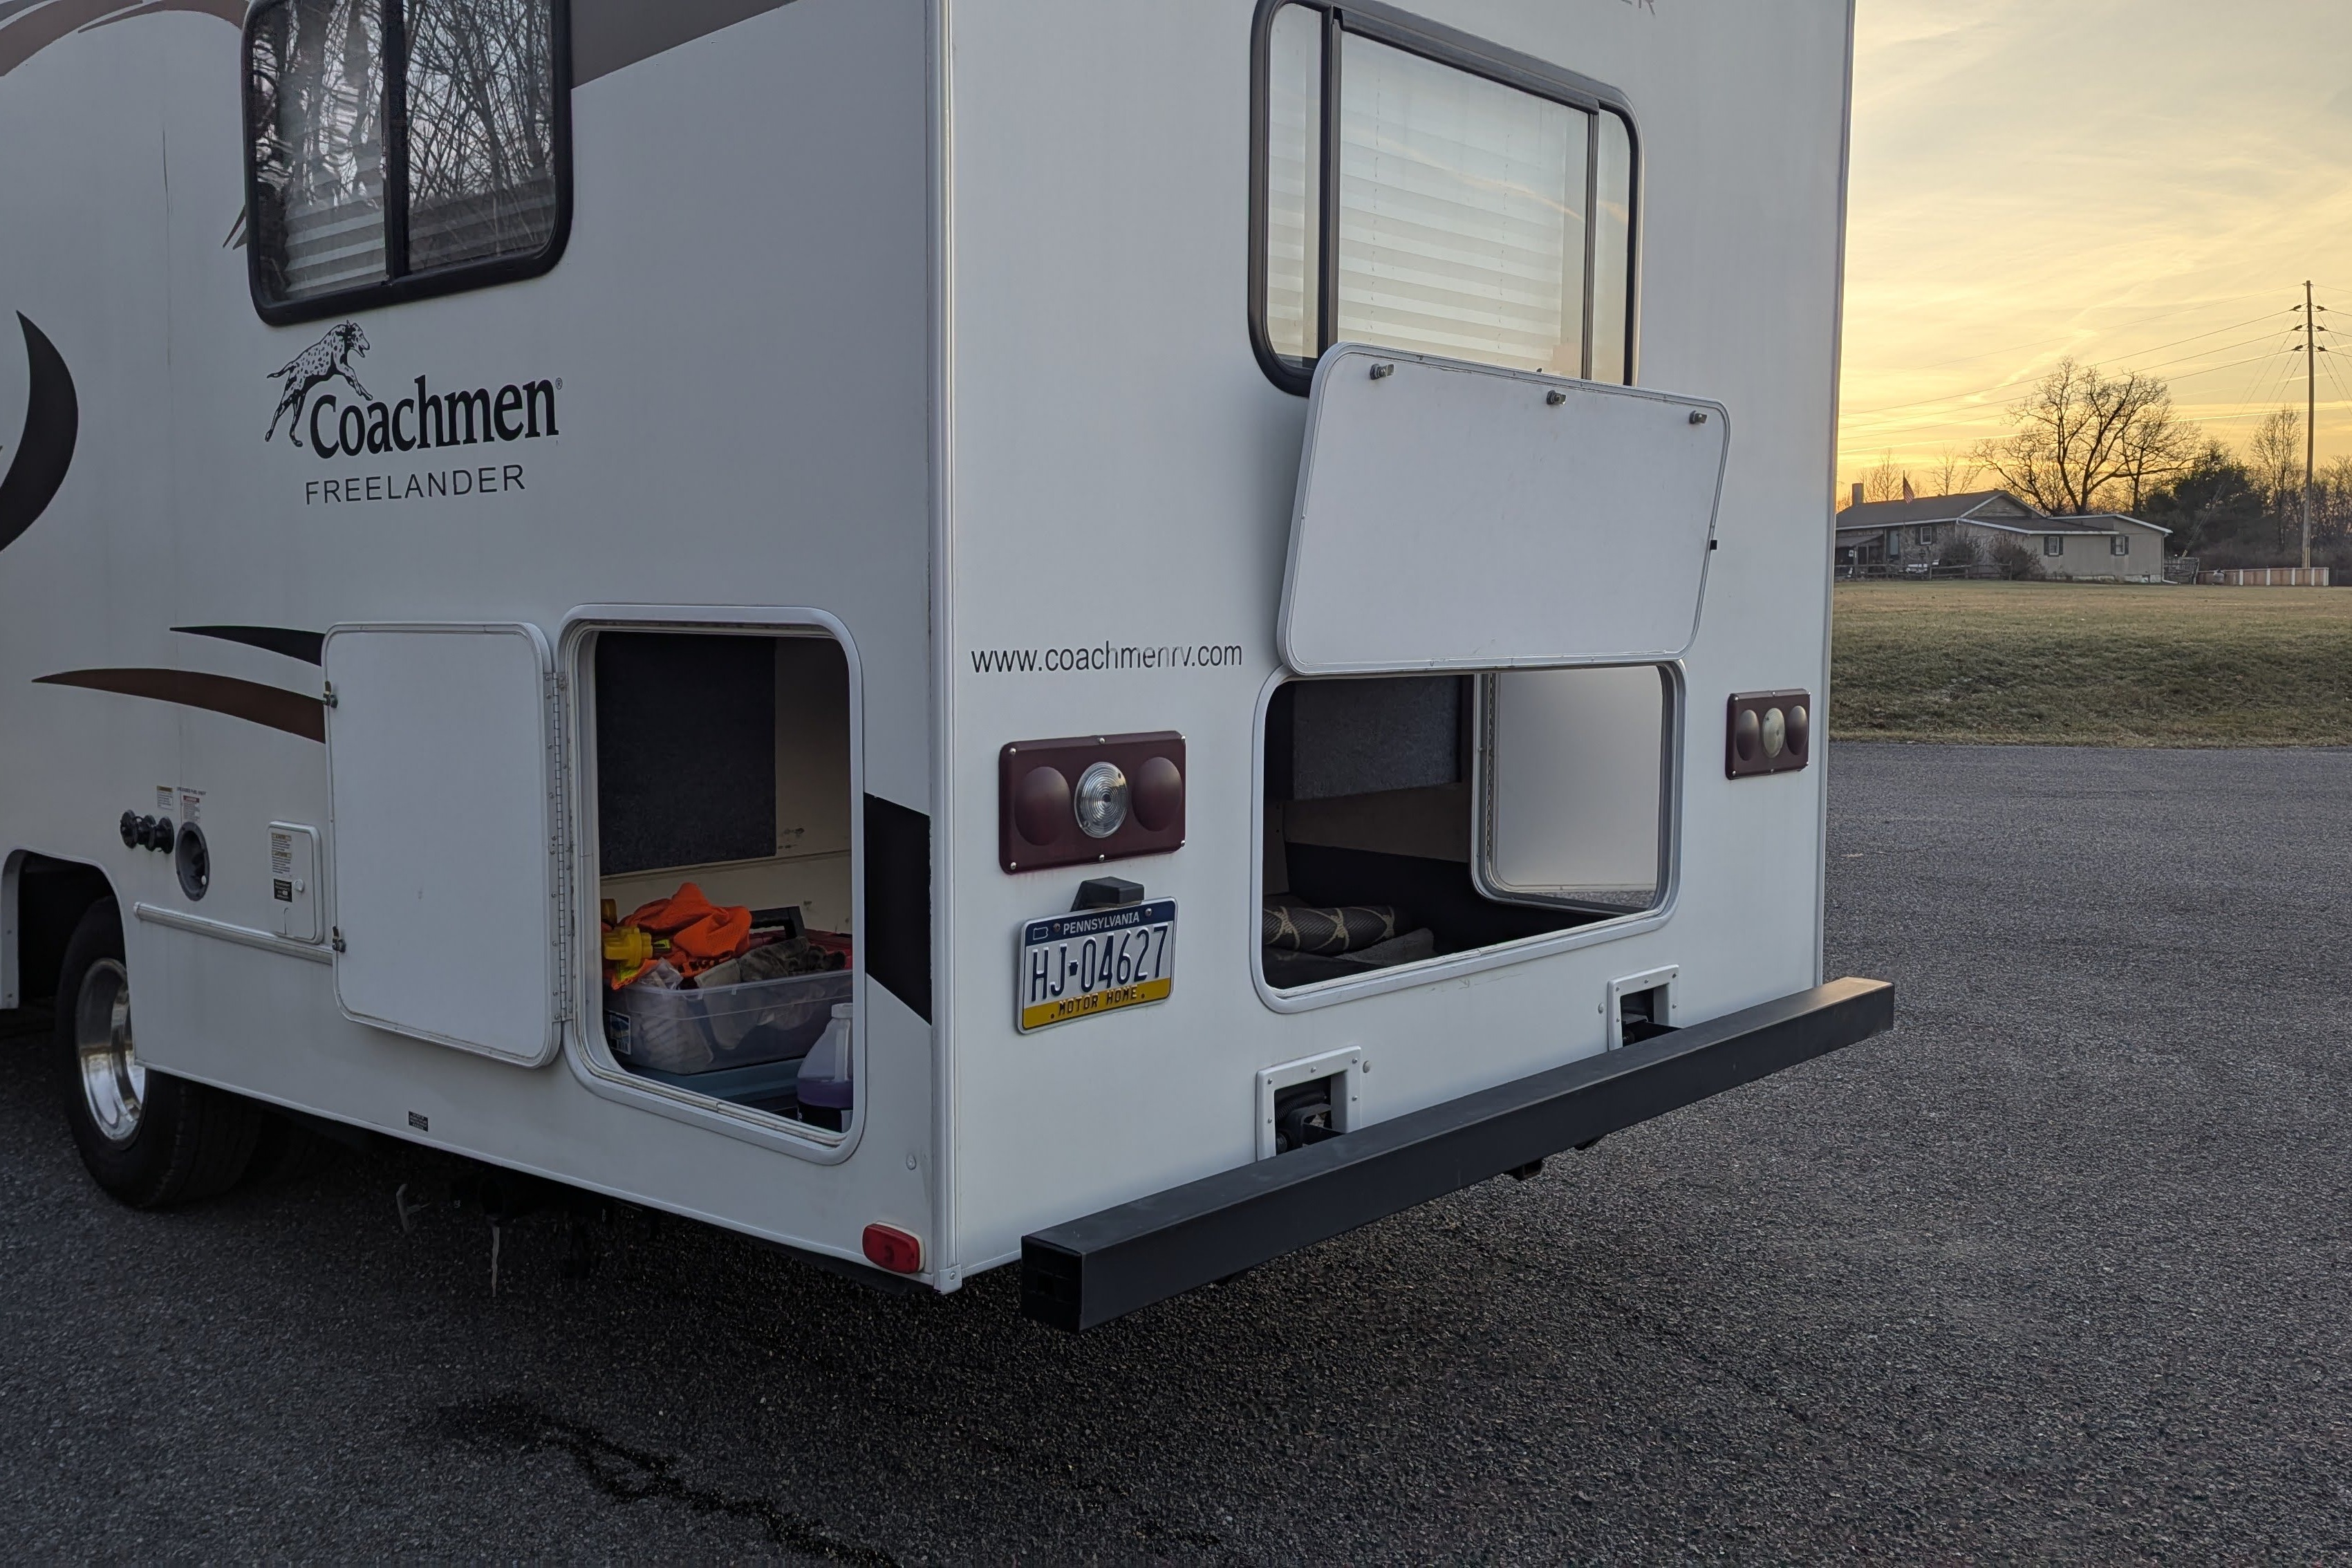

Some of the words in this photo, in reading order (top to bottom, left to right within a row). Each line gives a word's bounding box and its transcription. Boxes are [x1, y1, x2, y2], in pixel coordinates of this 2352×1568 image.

[305, 464, 525, 505] FREELANDER
[971, 640, 1242, 673] www.coachmenrv.com
[1063, 911, 1140, 935] PENNSYLVANIA
[1058, 993, 1099, 1016] MOTOR
[1106, 984, 1138, 1006] HOME
